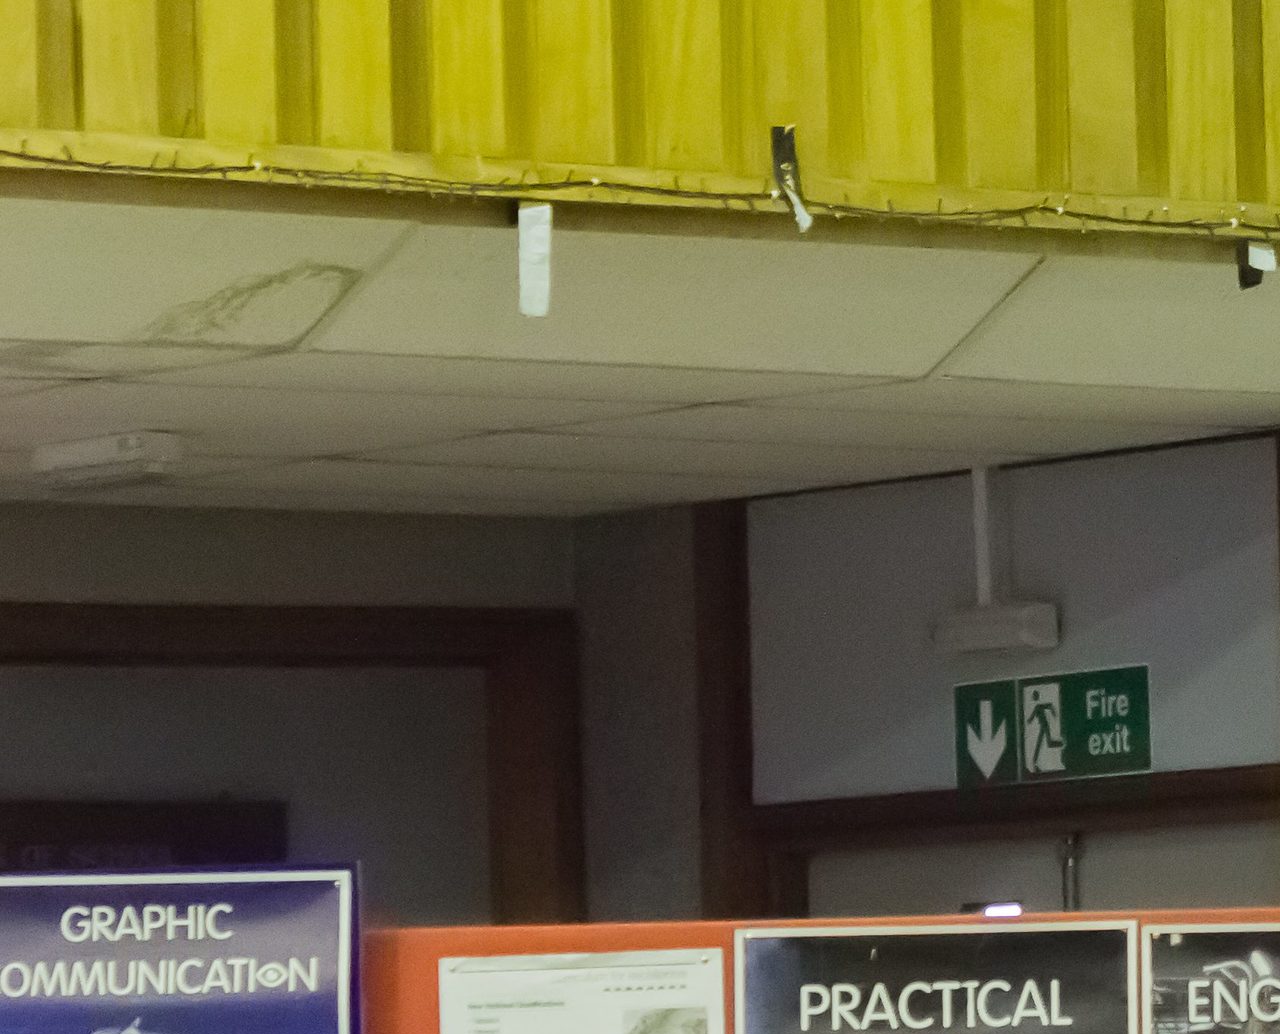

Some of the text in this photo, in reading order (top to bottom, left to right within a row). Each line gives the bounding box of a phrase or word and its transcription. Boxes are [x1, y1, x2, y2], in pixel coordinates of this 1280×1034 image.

[1086, 687, 1130, 720] Fire
[1087, 723, 1131, 756] exit
[60, 903, 235, 943] GRAPHIC
[0, 956, 320, 998] OMMUNICATION
[799, 979, 1074, 1032] PRACTICAL
